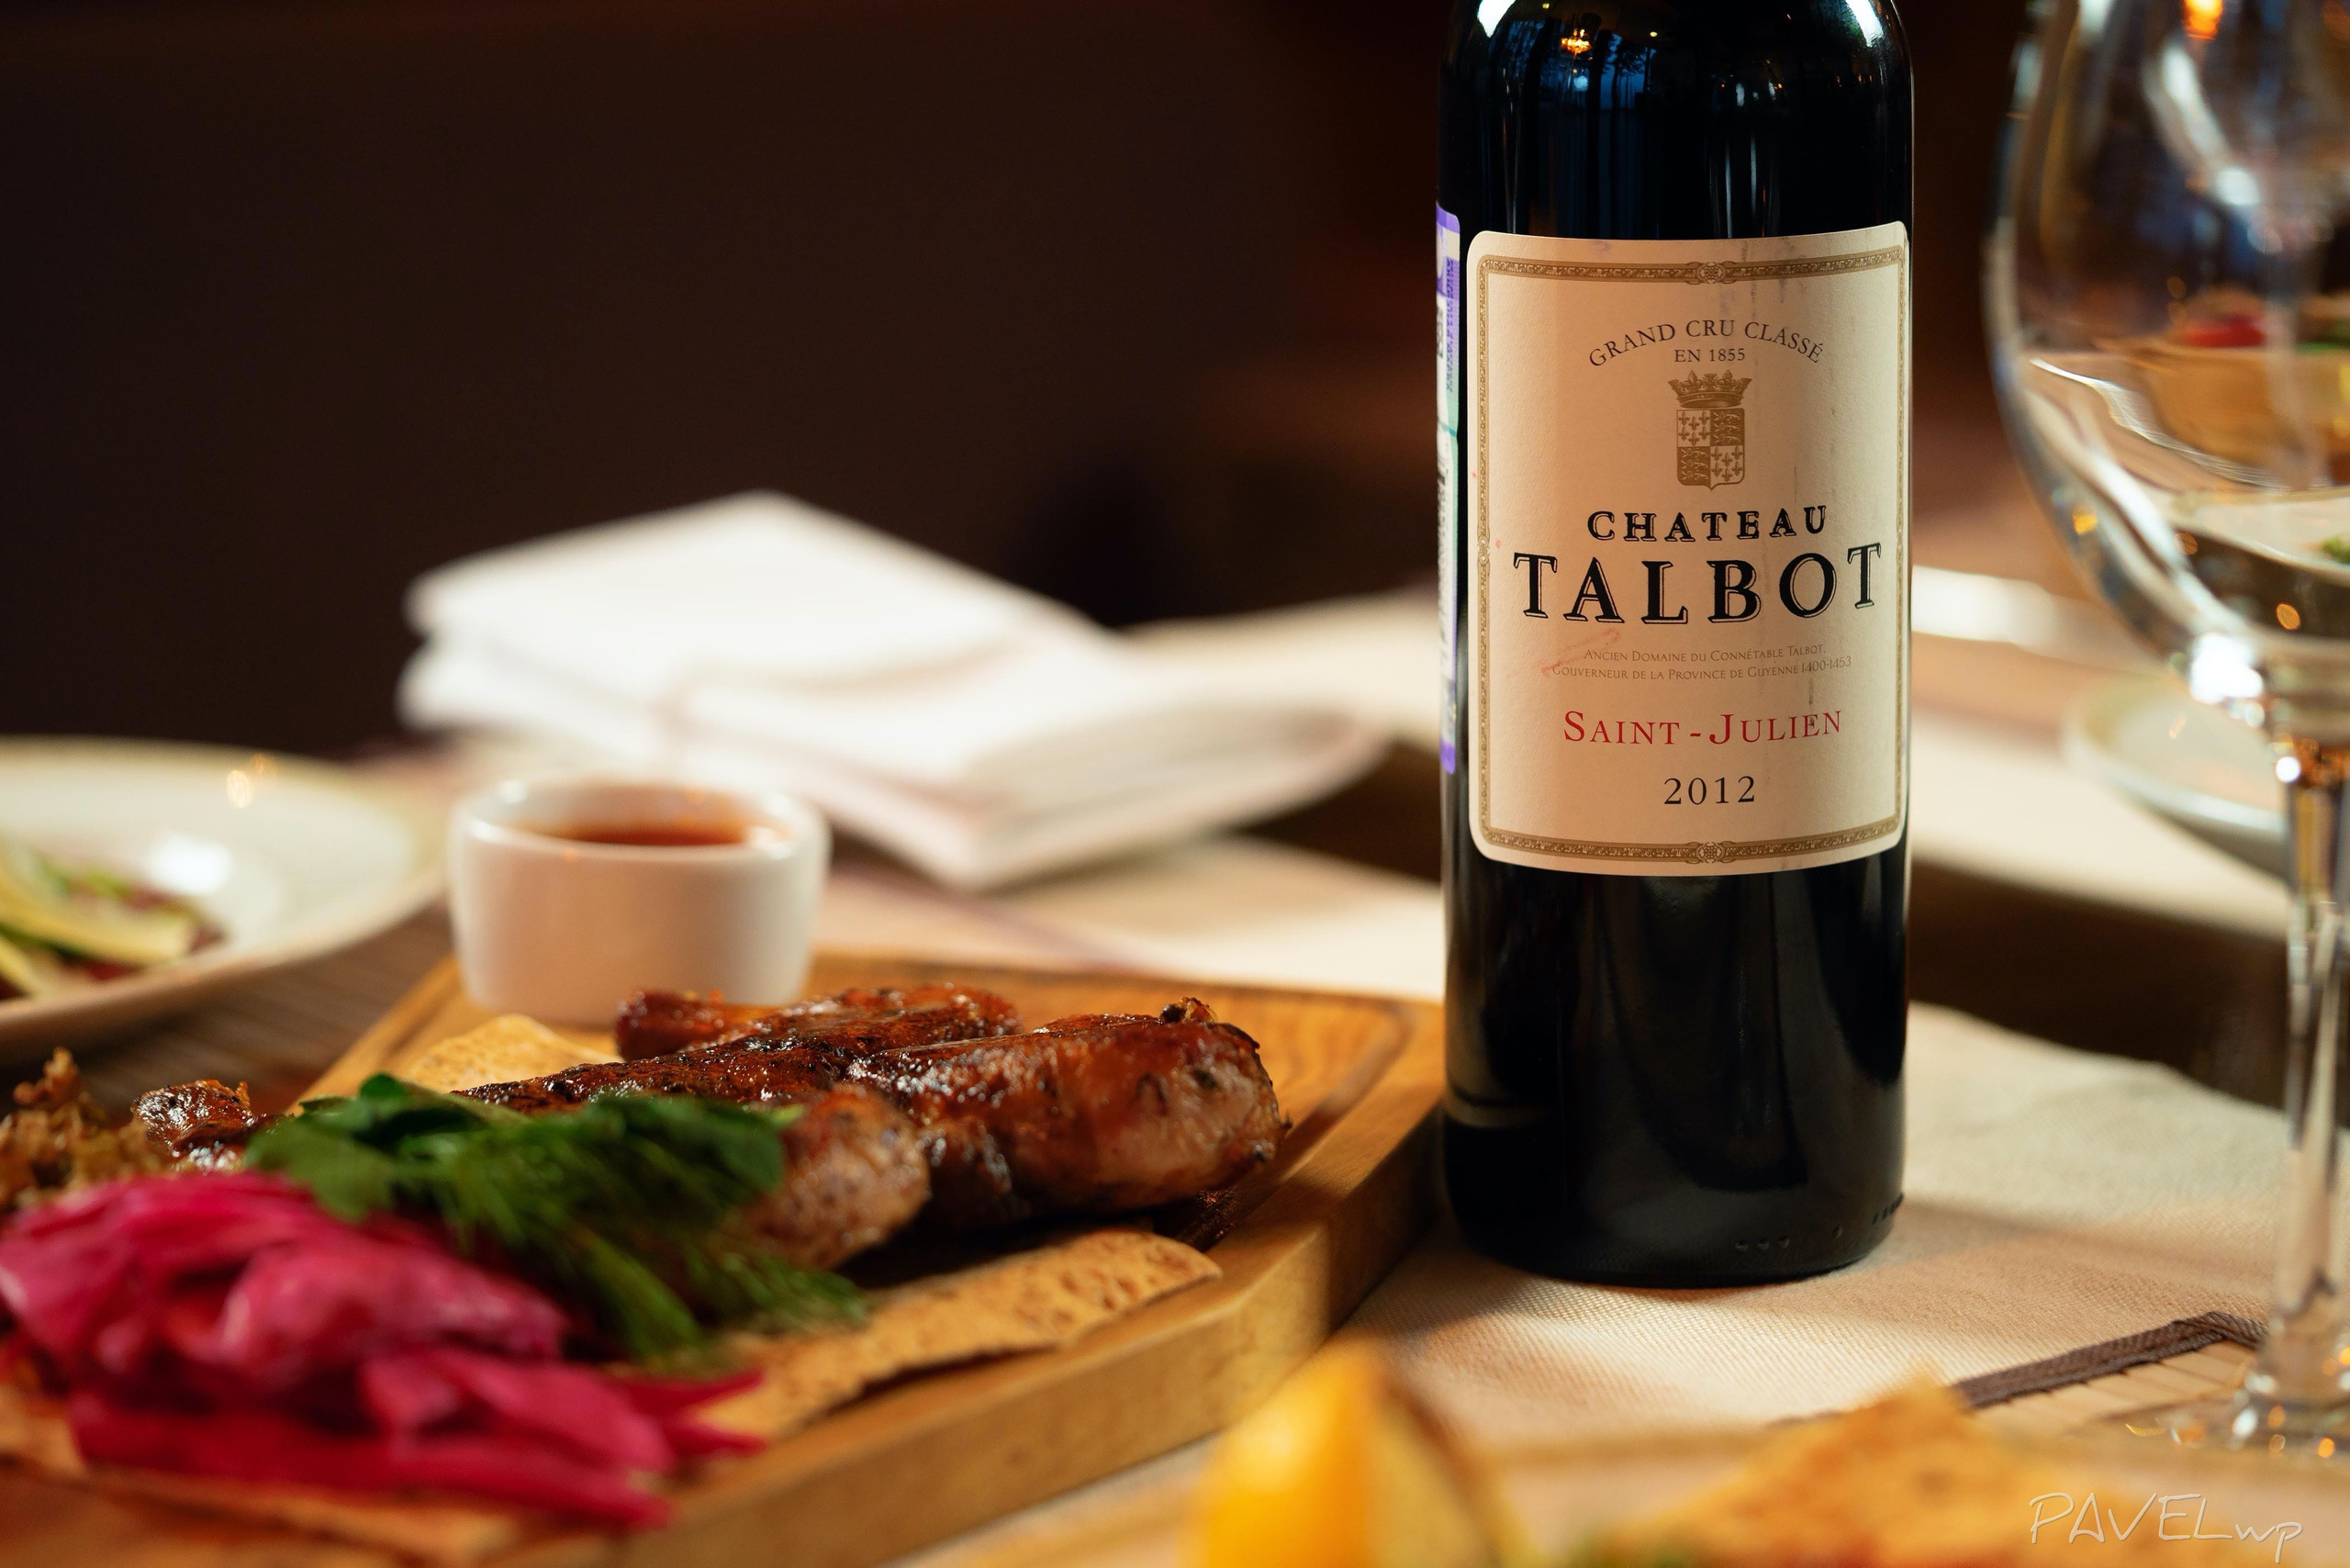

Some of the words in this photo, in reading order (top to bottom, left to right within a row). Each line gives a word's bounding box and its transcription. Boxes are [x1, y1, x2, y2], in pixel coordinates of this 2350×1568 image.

[1589, 323, 1676, 366] GRAND
[1685, 319, 1736, 338] CRU
[1744, 321, 1823, 364] CLASSÉ
[1673, 349, 1701, 363] EN
[1708, 348, 1746, 362] 1855
[1587, 505, 1827, 543] CHATEAU
[1513, 543, 1881, 625] TALBOT
[1663, 776, 1755, 805] 2012
